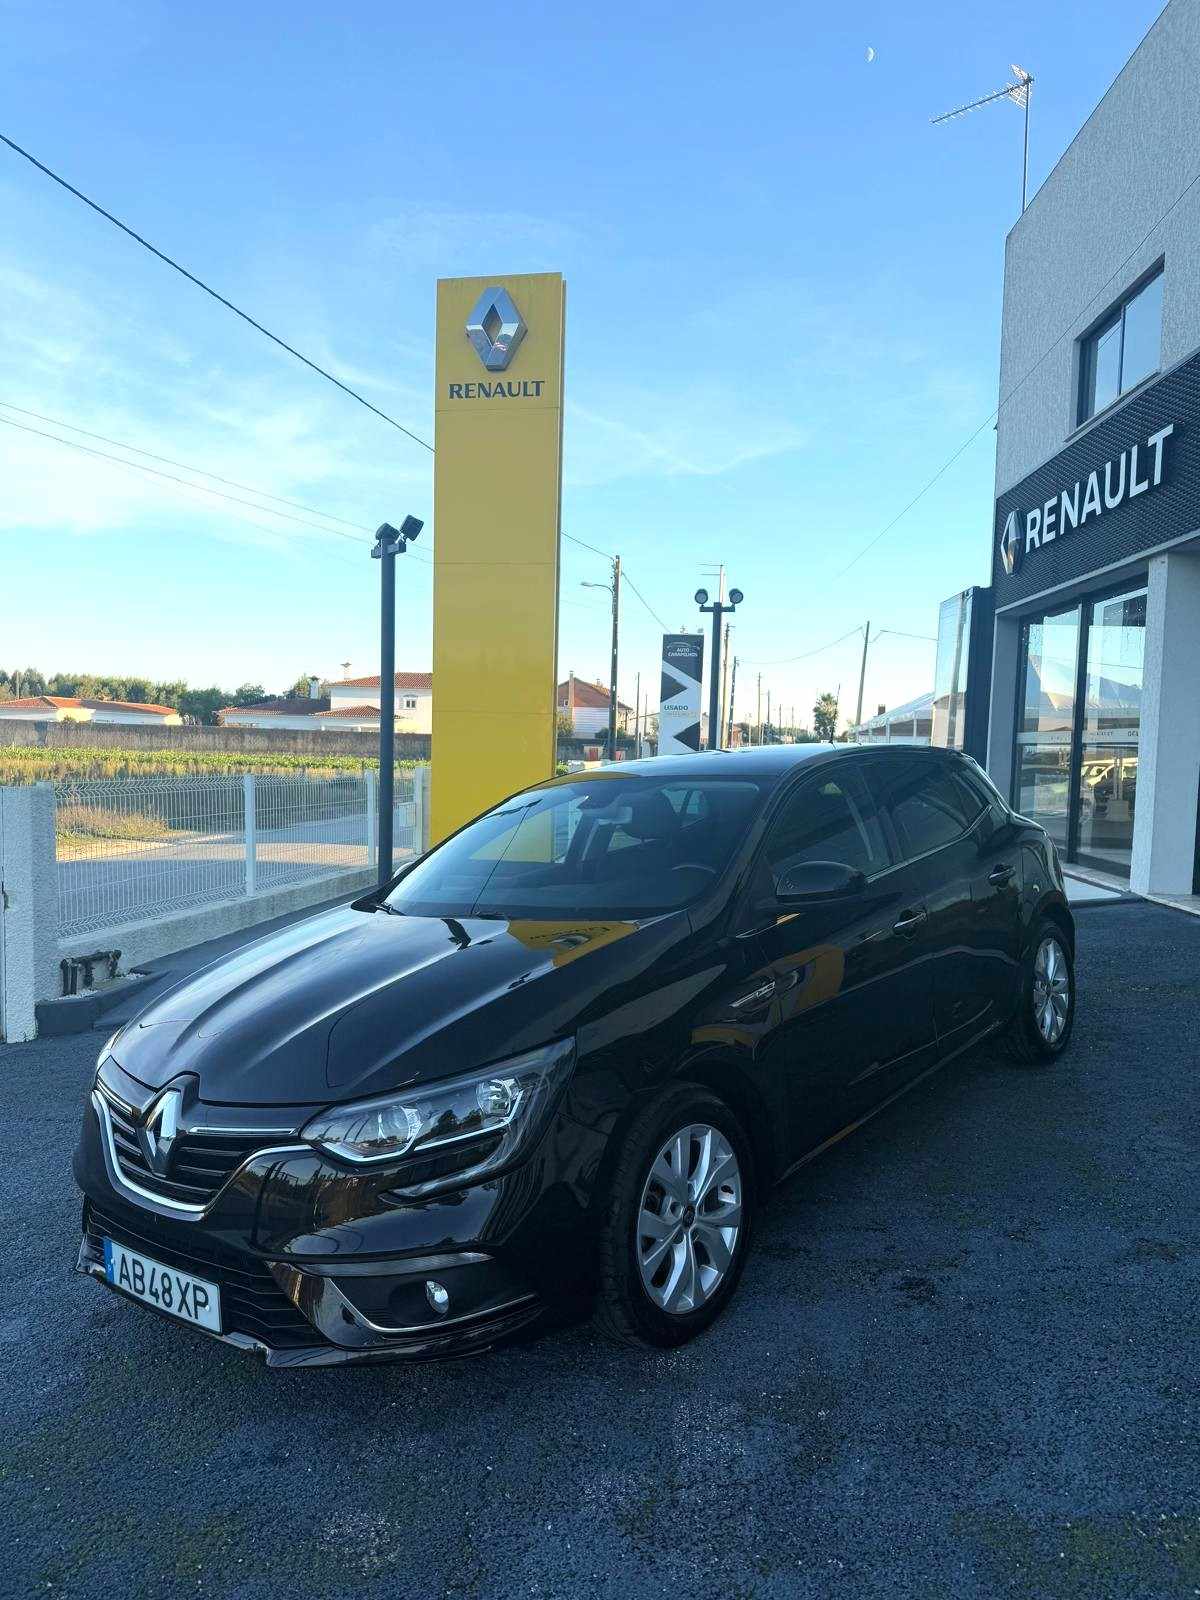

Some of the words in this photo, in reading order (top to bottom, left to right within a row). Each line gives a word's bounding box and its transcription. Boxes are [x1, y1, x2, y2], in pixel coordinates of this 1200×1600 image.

[448, 381, 545, 399] RENAULT
[1026, 424, 1174, 554] RENAULT
[119, 1253, 209, 1320] AB48XP
